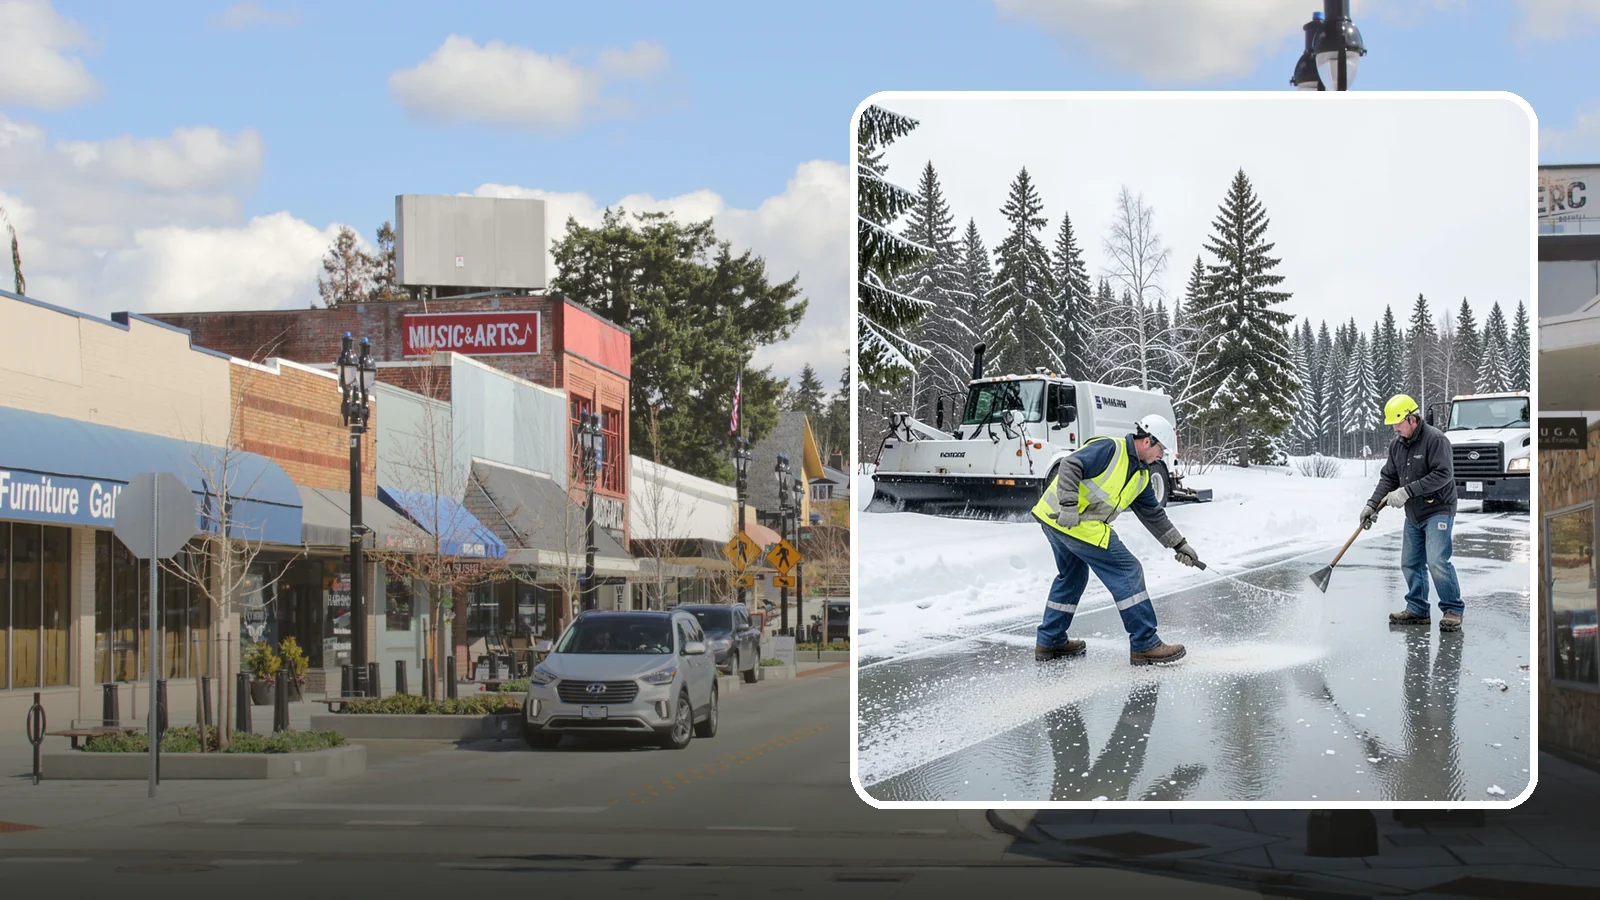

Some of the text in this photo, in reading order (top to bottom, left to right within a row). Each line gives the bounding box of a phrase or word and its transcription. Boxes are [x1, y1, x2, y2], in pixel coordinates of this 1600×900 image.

[408, 322, 520, 349] MUSIC&ARTS
[1540, 427, 1578, 437] UGA
[0, 472, 122, 519] Furniture Gal
[453, 563, 480, 575] SUSHI
